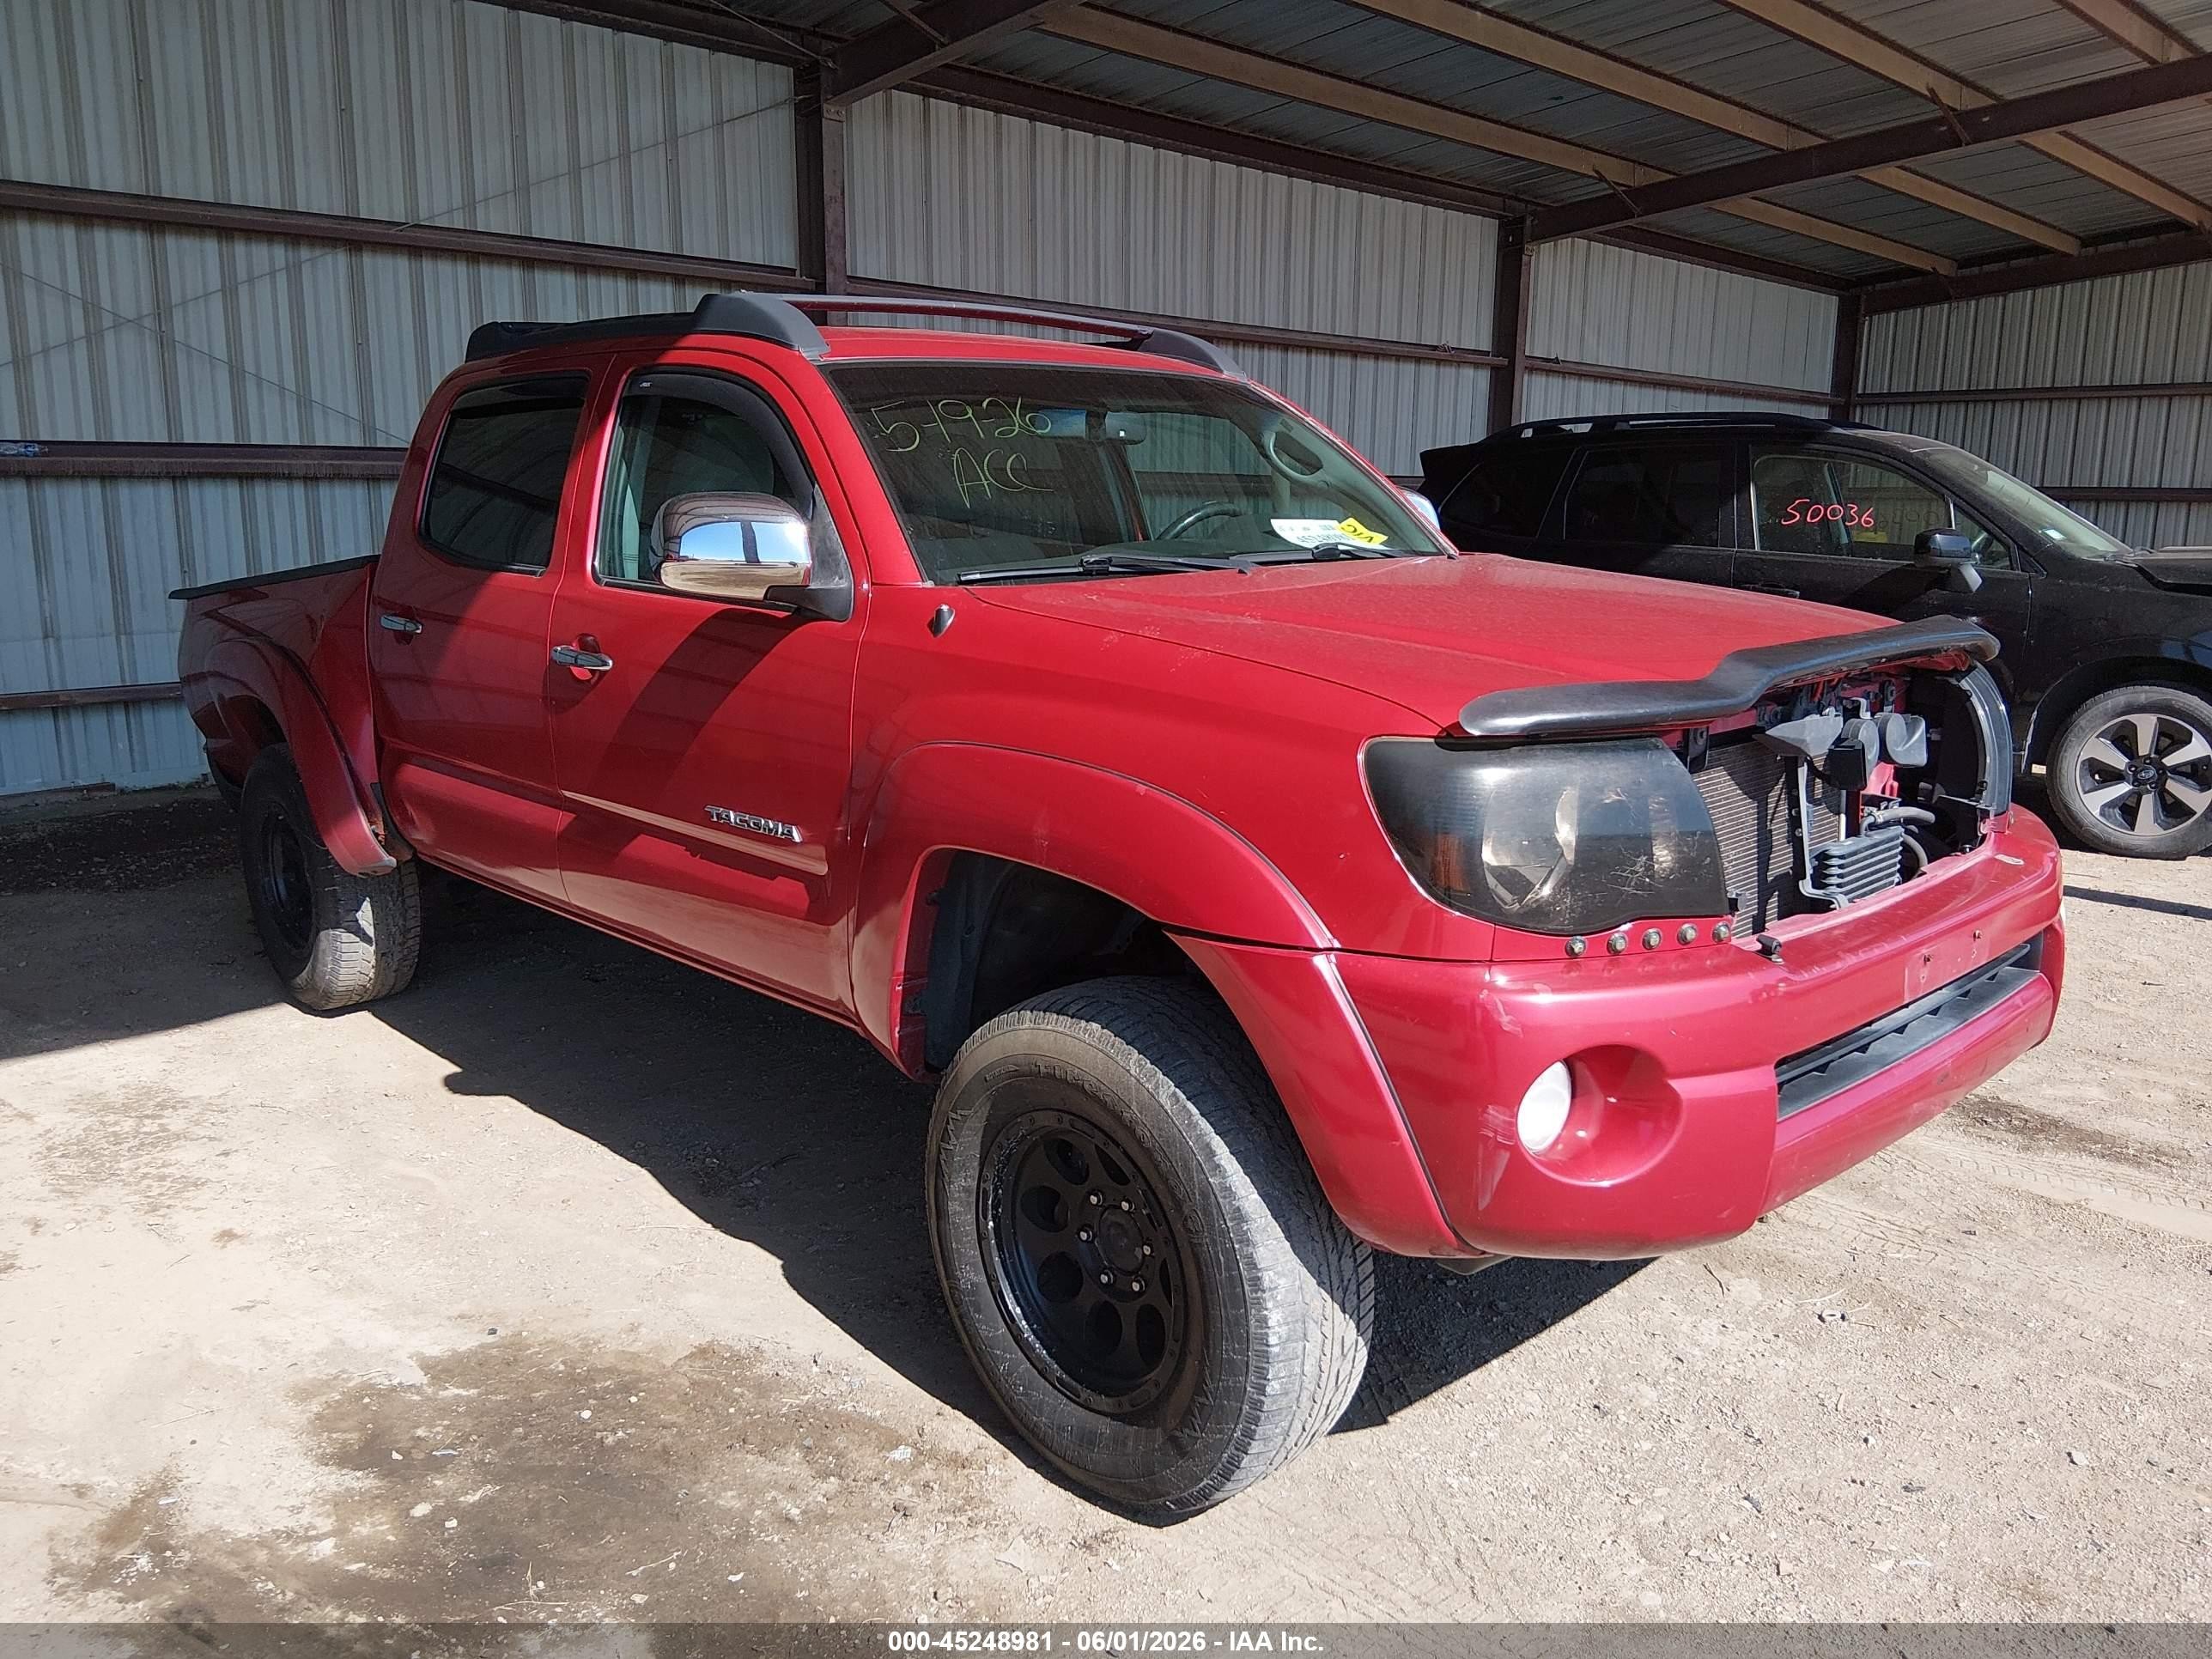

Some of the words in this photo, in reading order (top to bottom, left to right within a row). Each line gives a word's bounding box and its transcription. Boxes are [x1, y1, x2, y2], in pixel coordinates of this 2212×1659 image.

[870, 396, 1052, 452] 5-19-26
[952, 447, 1055, 508] ACC
[1781, 499, 1875, 528] 50036
[703, 805, 803, 843] TACOMA
